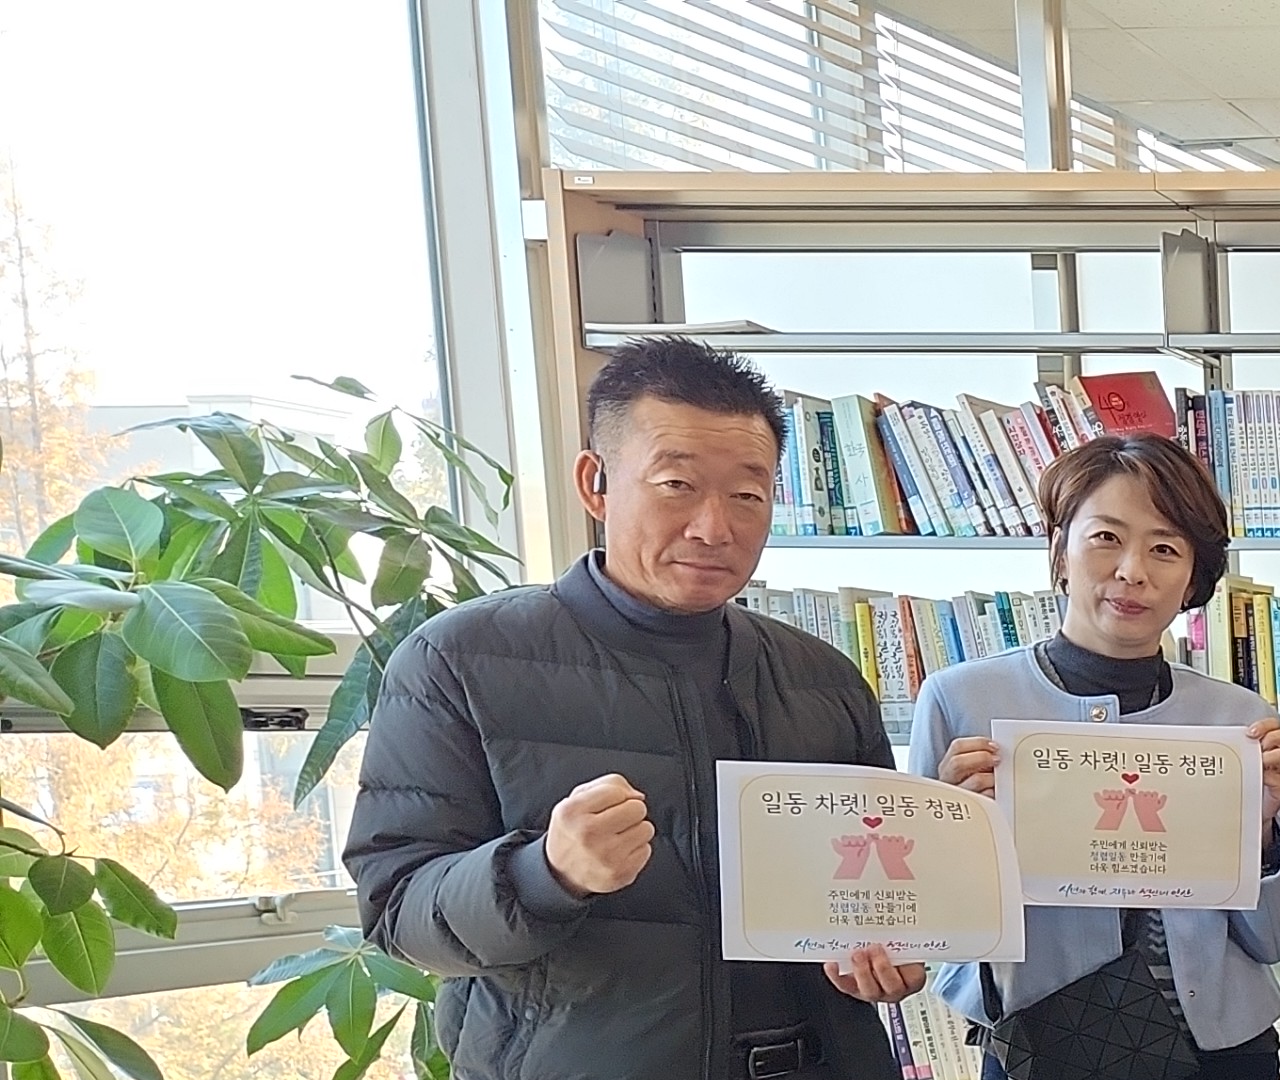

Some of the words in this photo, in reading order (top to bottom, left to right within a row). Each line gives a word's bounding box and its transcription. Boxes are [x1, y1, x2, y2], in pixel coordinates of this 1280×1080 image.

[1033, 748, 1073, 770] 일동
[1080, 751, 1126, 773] 차렷!
[1134, 753, 1173, 774] 일동
[1179, 754, 1223, 776] 청렴!
[762, 792, 807, 814] 일동
[815, 793, 867, 816] 차렷!
[876, 796, 919, 818] 일동
[925, 798, 971, 820] 청렴!
[1090, 840, 1126, 850] 주민에게
[1130, 841, 1167, 851] 신뢰받는
[1090, 852, 1126, 861] 청렴일동
[1130, 852, 1166, 862] 만들기에
[1090, 863, 1108, 873] 더욱
[1112, 864, 1166, 874] 힘쓰겠습니다
[828, 890, 871, 900] 주민에게
[875, 890, 917, 901] 신뢰받는
[829, 903, 871, 913] 청렴일동
[875, 904, 917, 913] 만들기에
[829, 915, 850, 925] 더욱
[854, 915, 917, 926] 힘쓰겠습니다
